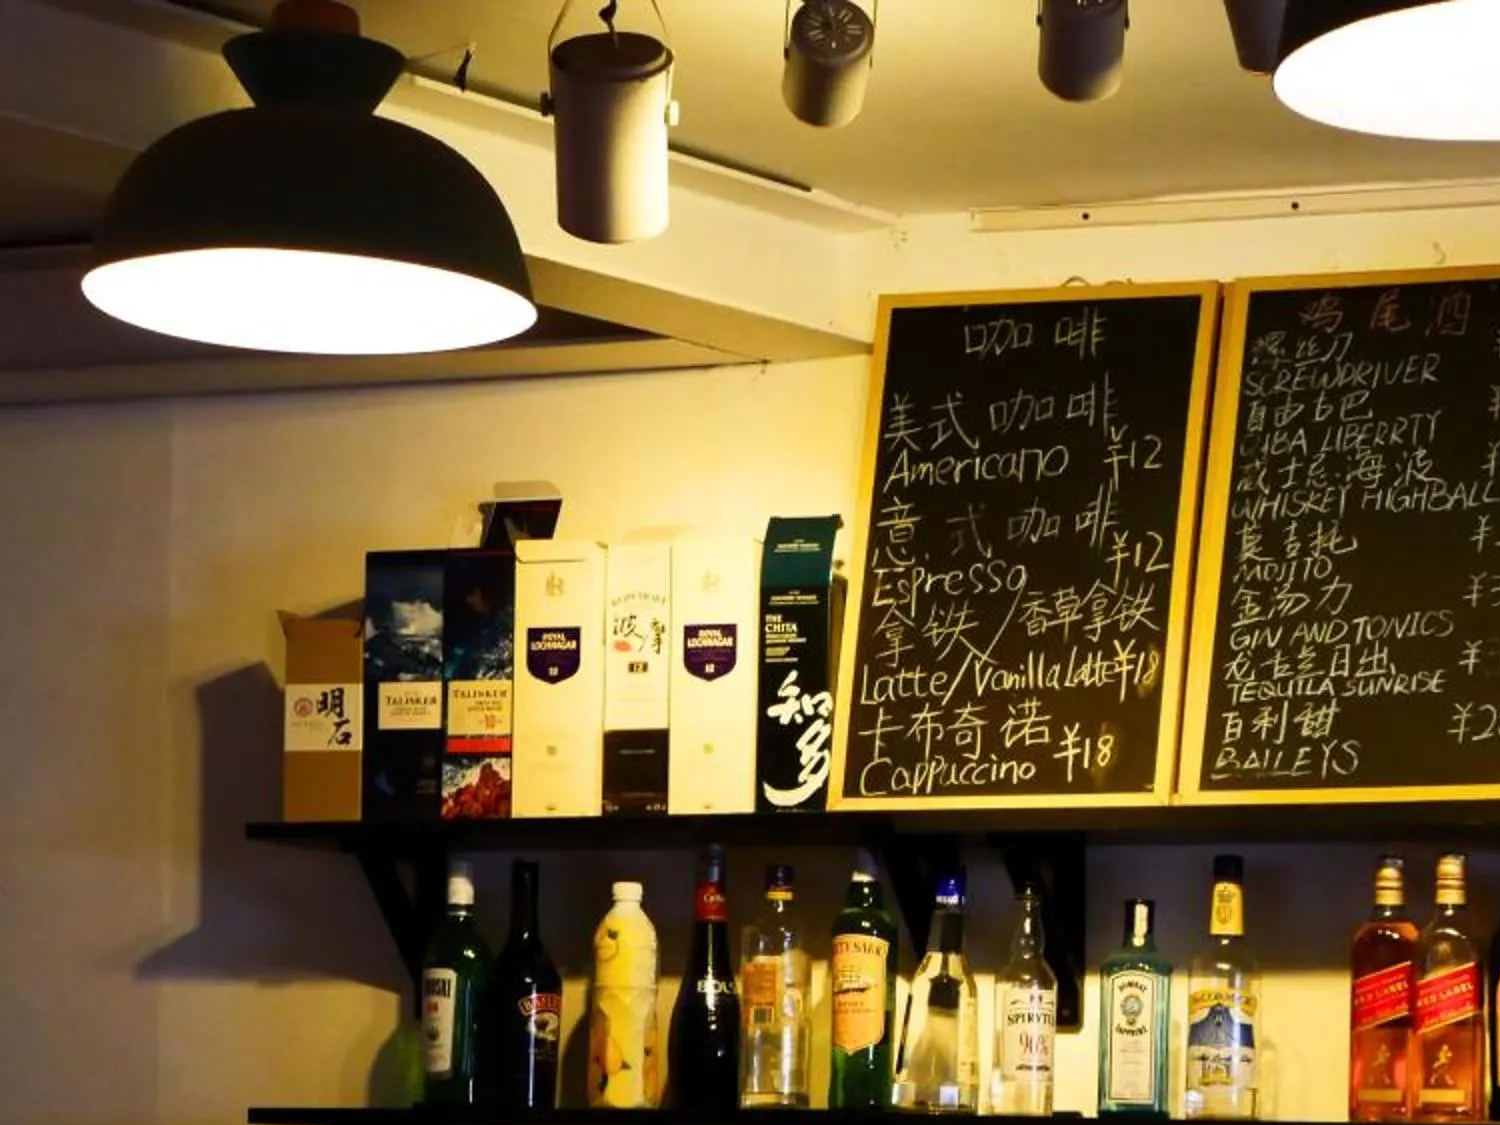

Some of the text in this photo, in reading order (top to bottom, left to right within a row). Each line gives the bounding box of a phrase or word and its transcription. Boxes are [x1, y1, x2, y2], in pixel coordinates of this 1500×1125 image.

[964, 306, 1107, 359] 咖啡
[1245, 354, 1440, 397] SCREWDRIVER
[884, 446, 1069, 493] Americano
[1232, 484, 1349, 520] WHISKEY
[1230, 626, 1283, 651] GIN
[1353, 610, 1454, 644] TONICS
[1341, 670, 1447, 697] SUNRISE
[858, 698, 1052, 762] 卡布奇诺
[860, 755, 1036, 797] Cappuccino
